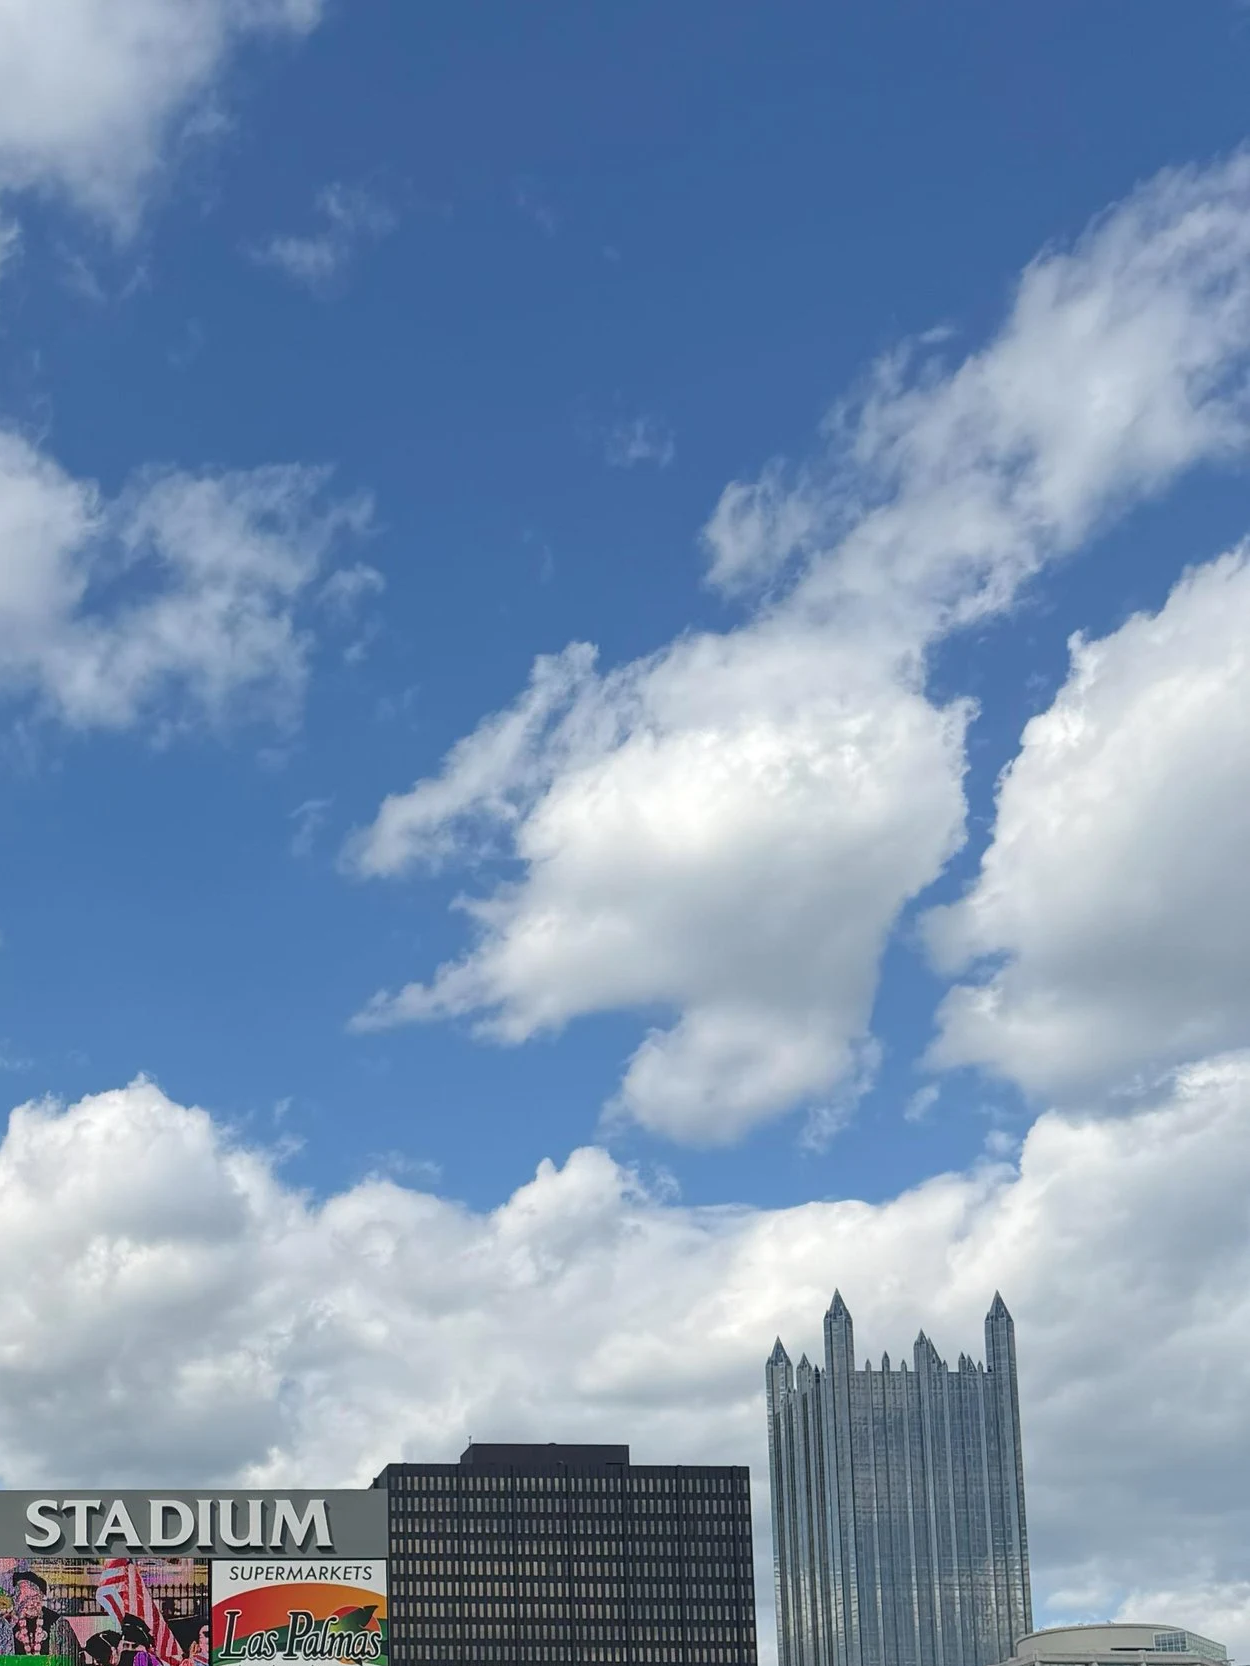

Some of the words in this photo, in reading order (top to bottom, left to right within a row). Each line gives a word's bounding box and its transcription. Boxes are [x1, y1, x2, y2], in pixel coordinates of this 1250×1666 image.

[25, 1500, 334, 1547] STADIUM
[229, 1566, 372, 1580] SUPERMARKETS
[219, 1610, 278, 1660] Las
[282, 1610, 382, 1660] Palmas
